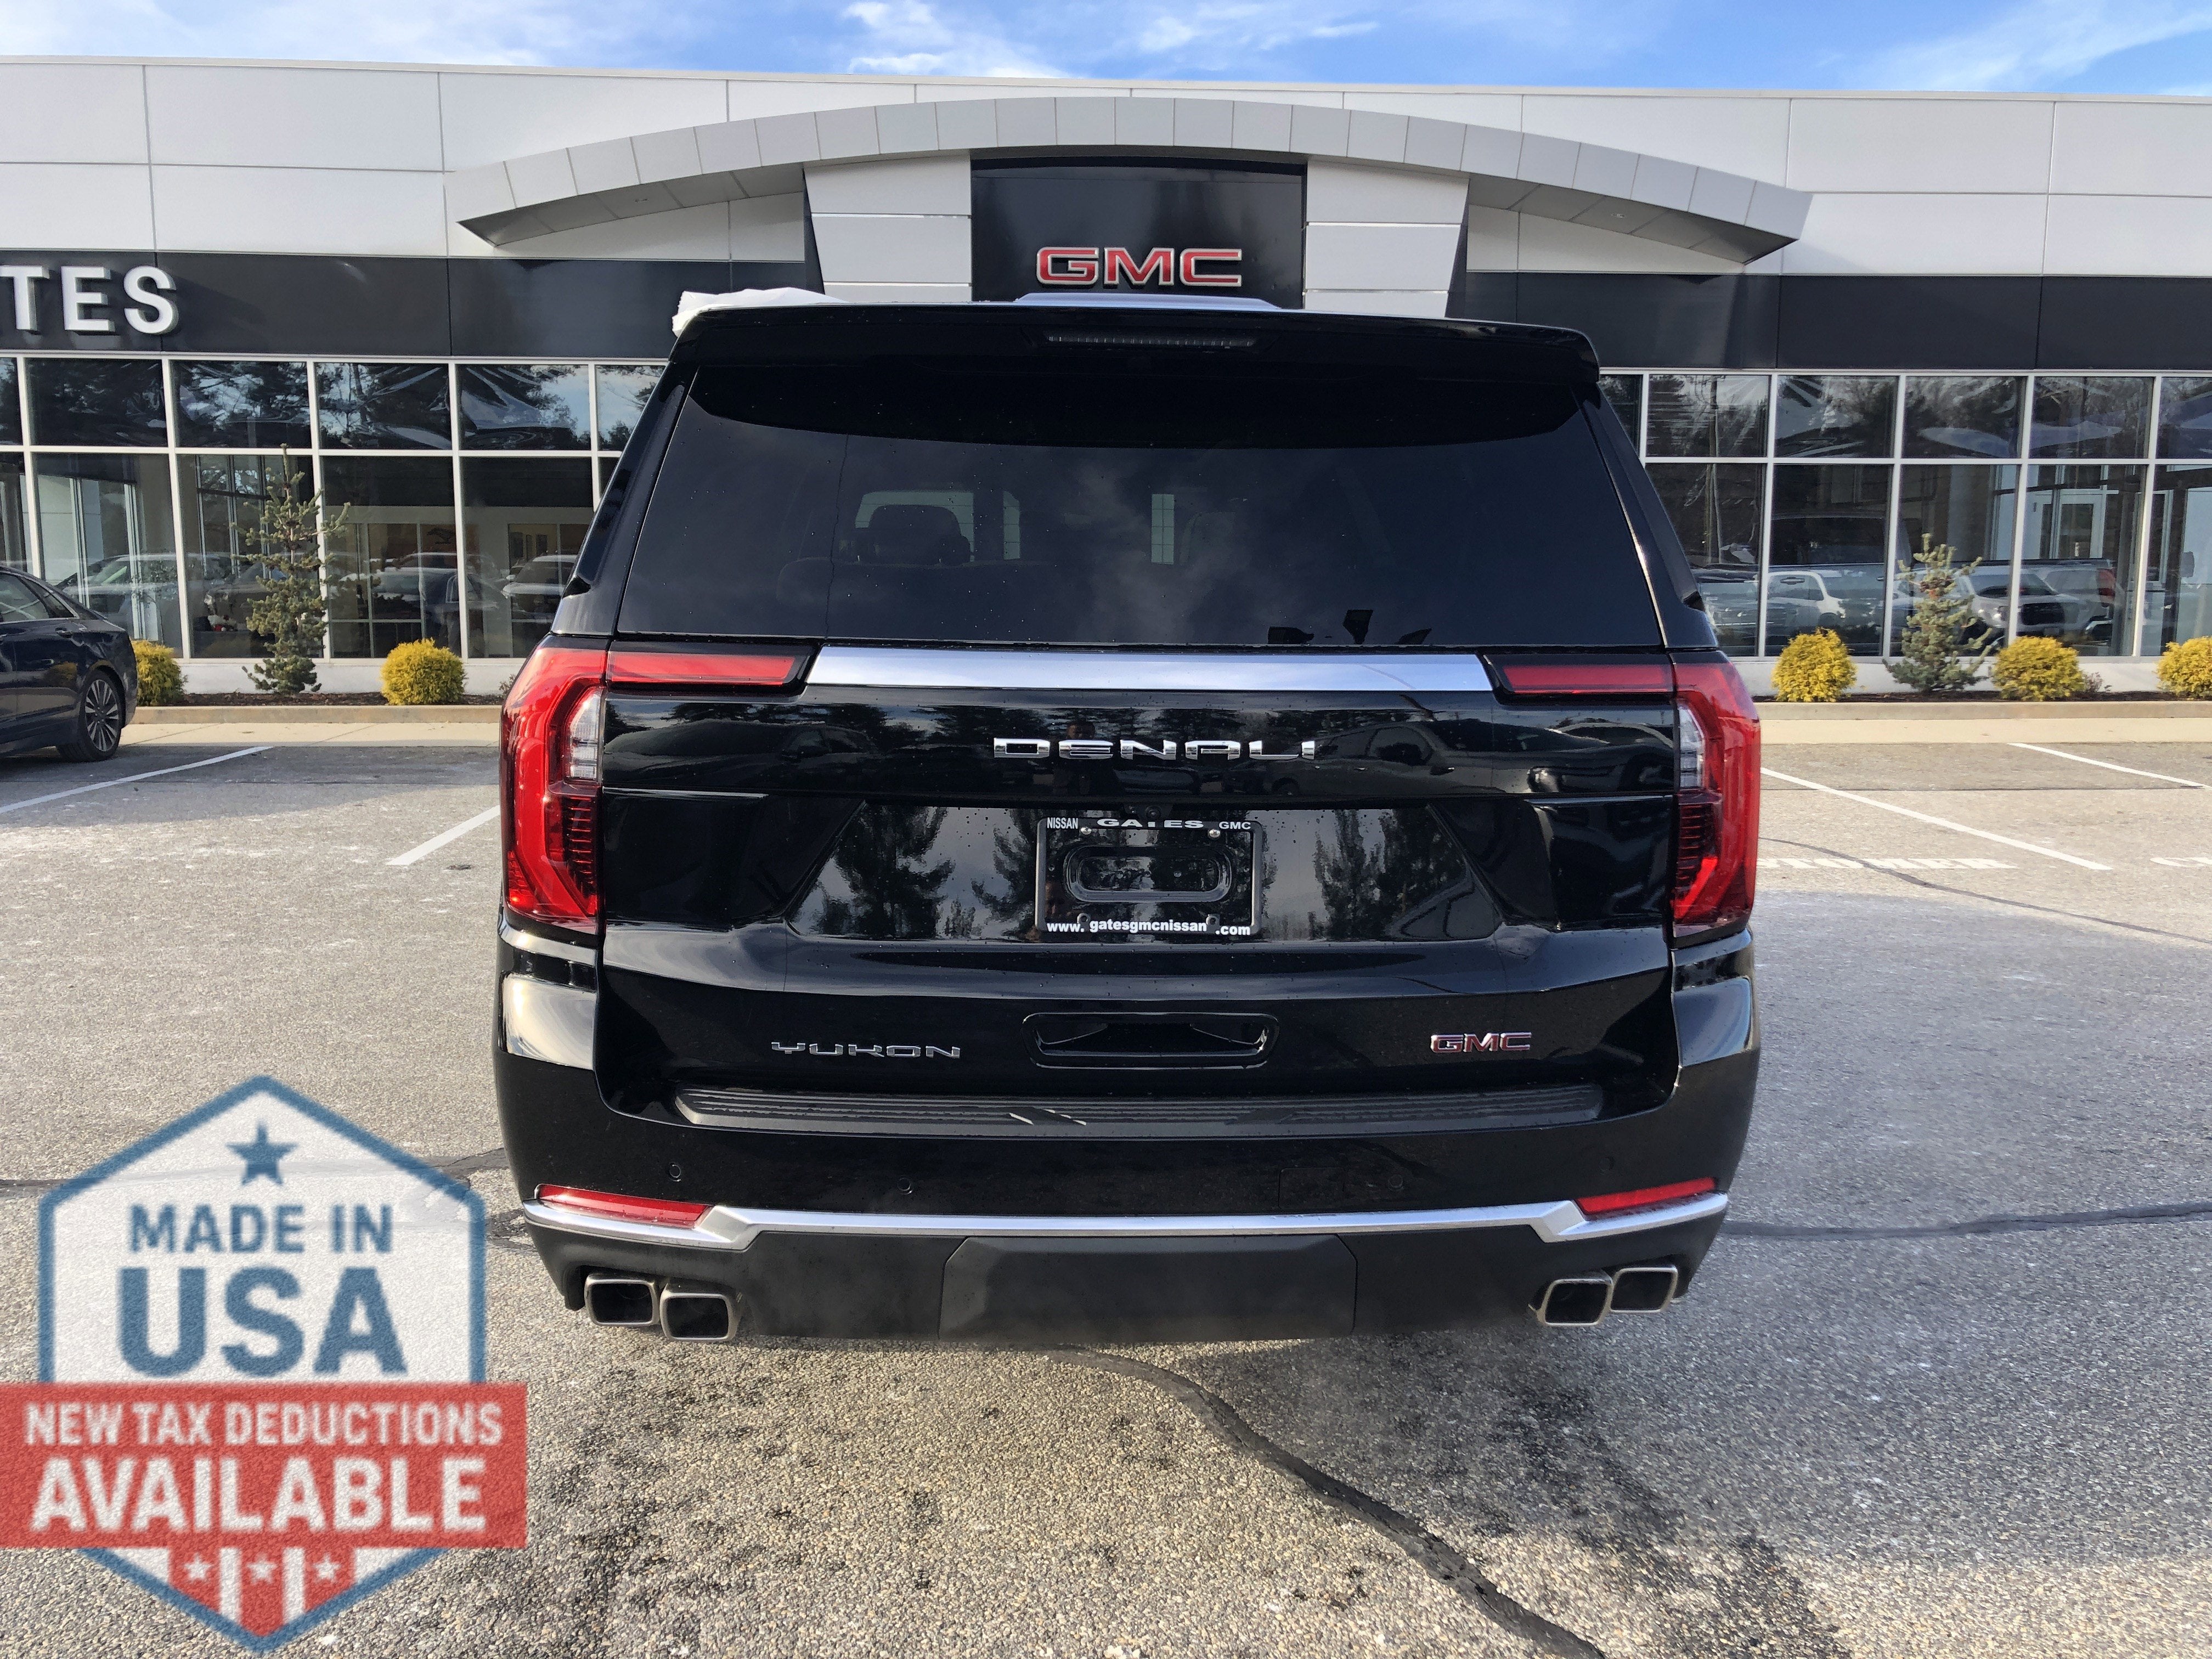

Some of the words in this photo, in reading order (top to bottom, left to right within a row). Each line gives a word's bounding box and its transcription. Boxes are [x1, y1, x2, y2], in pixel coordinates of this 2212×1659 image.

[1036, 247, 1242, 287] GMC
[994, 738, 1315, 760] DENALI
[1047, 817, 1078, 830] NISSAN
[1219, 821, 1251, 830] GMC
[771, 1042, 960, 1058] YUKON
[1430, 1031, 1532, 1053] GMC
